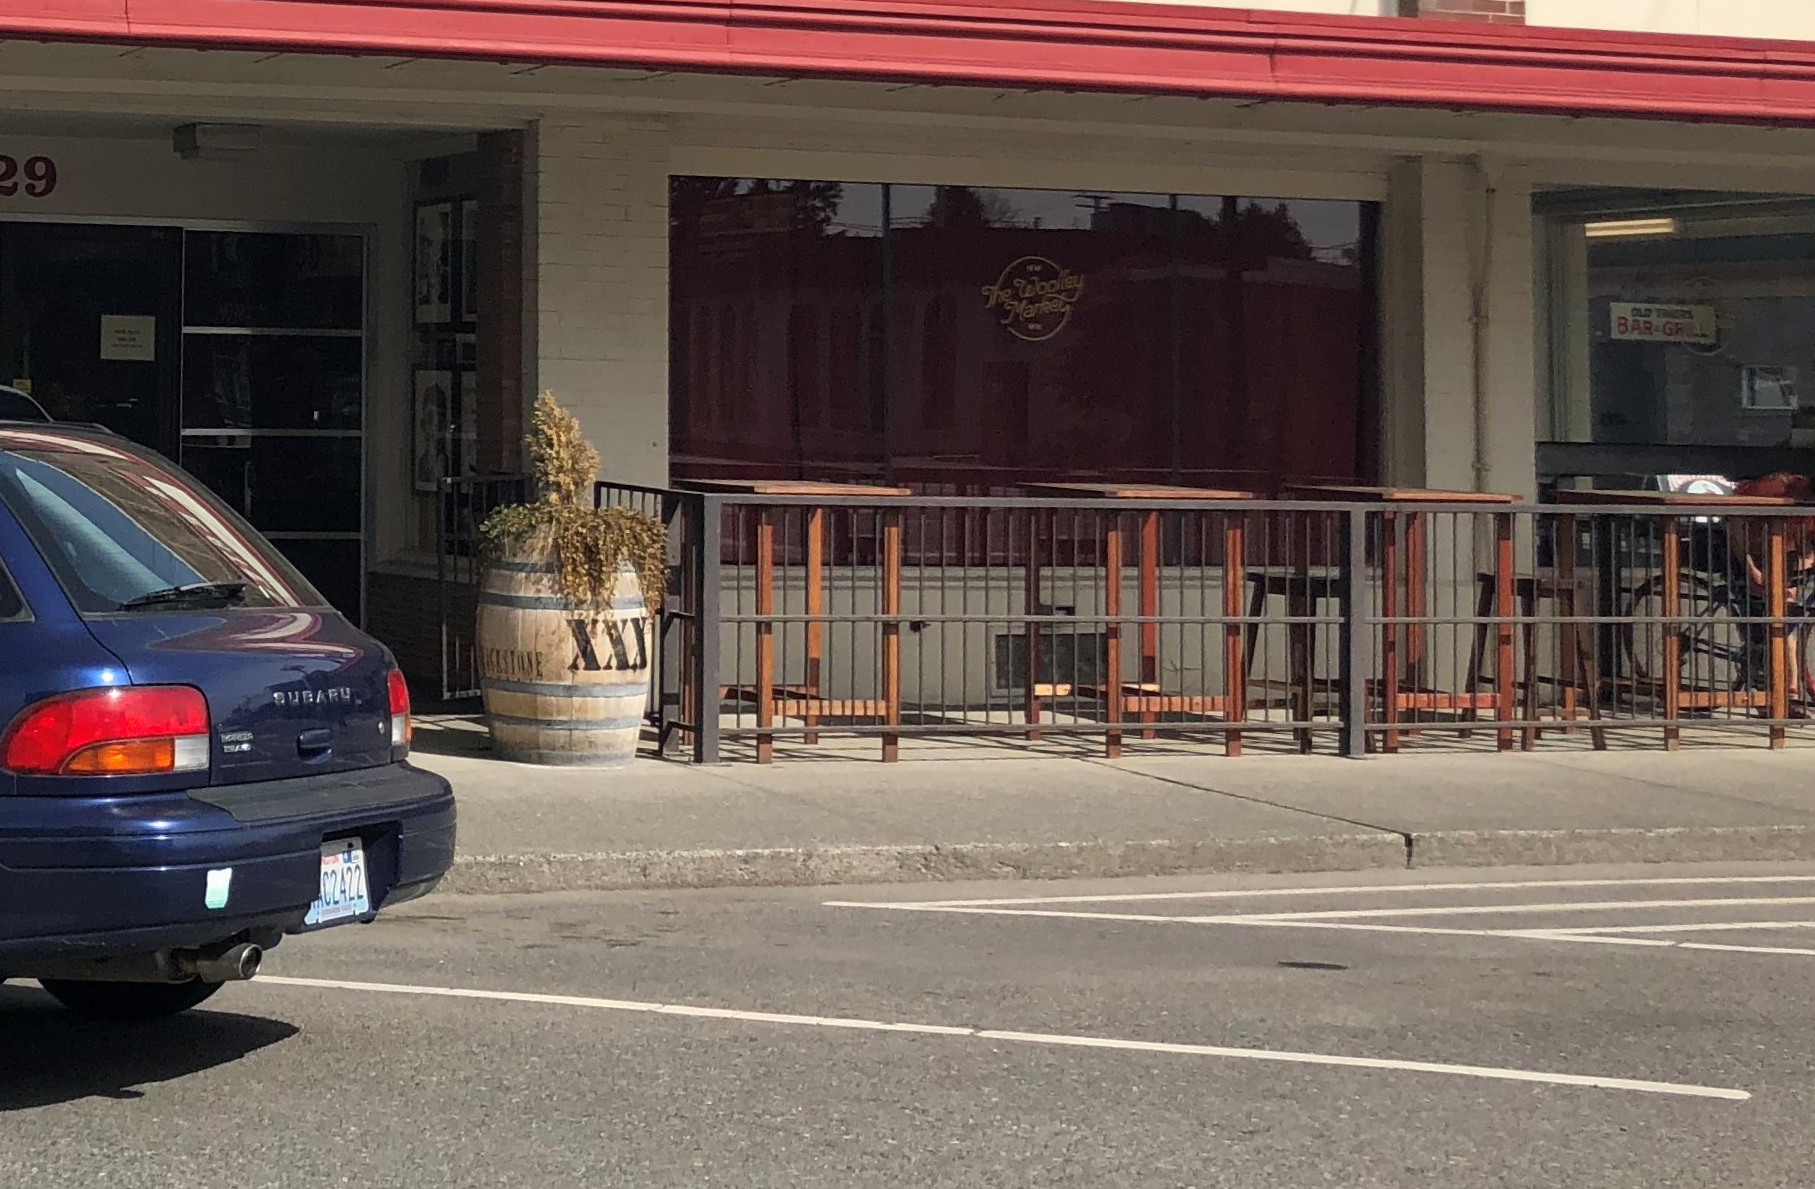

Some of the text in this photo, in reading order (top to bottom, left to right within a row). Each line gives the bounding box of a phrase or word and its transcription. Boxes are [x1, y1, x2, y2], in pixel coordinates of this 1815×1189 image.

[981, 269, 1084, 308] The Woolley
[1617, 315, 1653, 336] BAR
[273, 687, 351, 706] SUBARU
